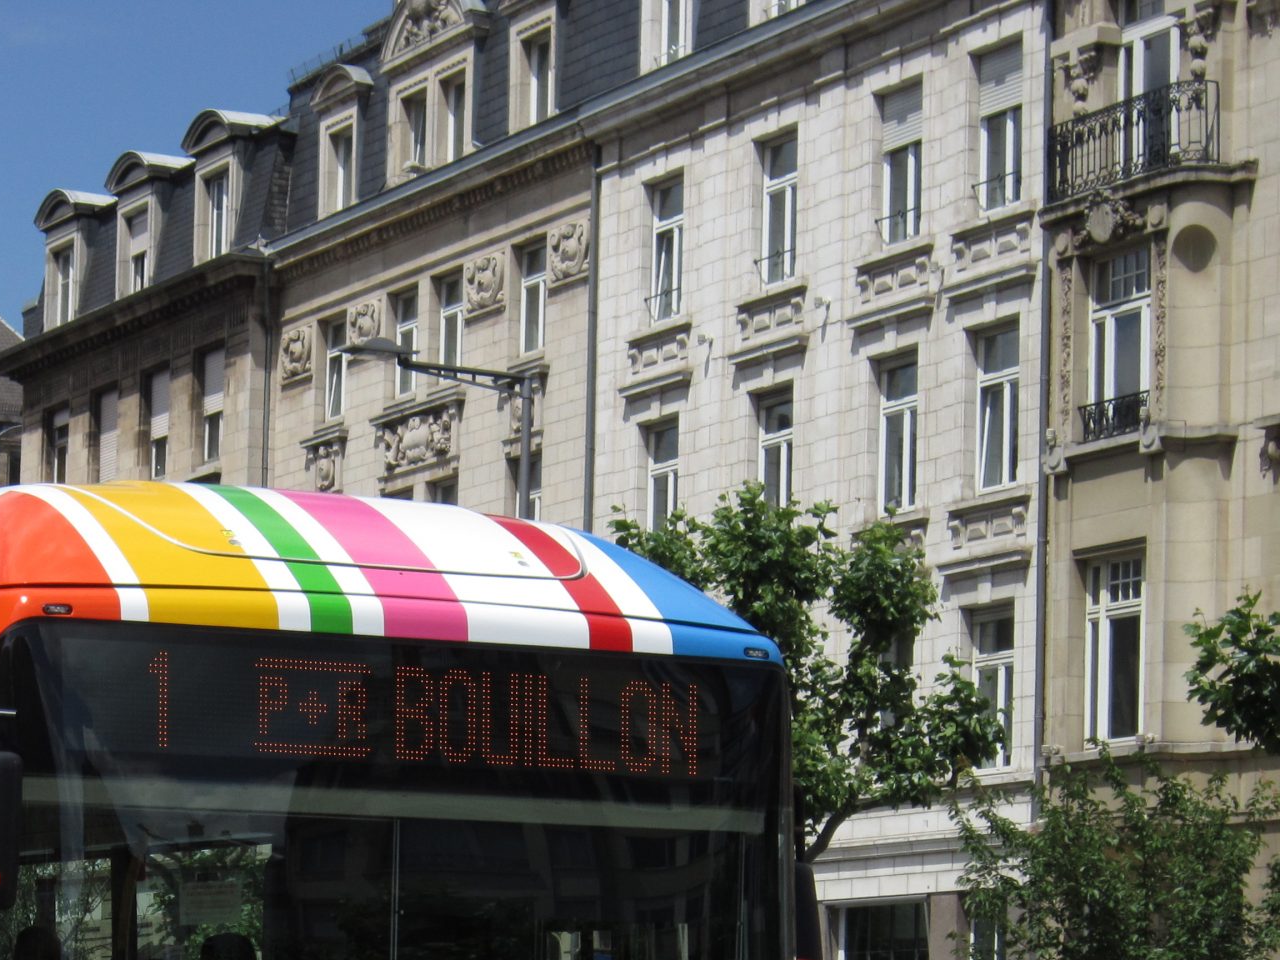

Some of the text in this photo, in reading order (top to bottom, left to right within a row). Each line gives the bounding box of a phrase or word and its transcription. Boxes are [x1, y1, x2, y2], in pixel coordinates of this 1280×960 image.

[149, 650, 698, 777] 1 P+R BOUILLON
